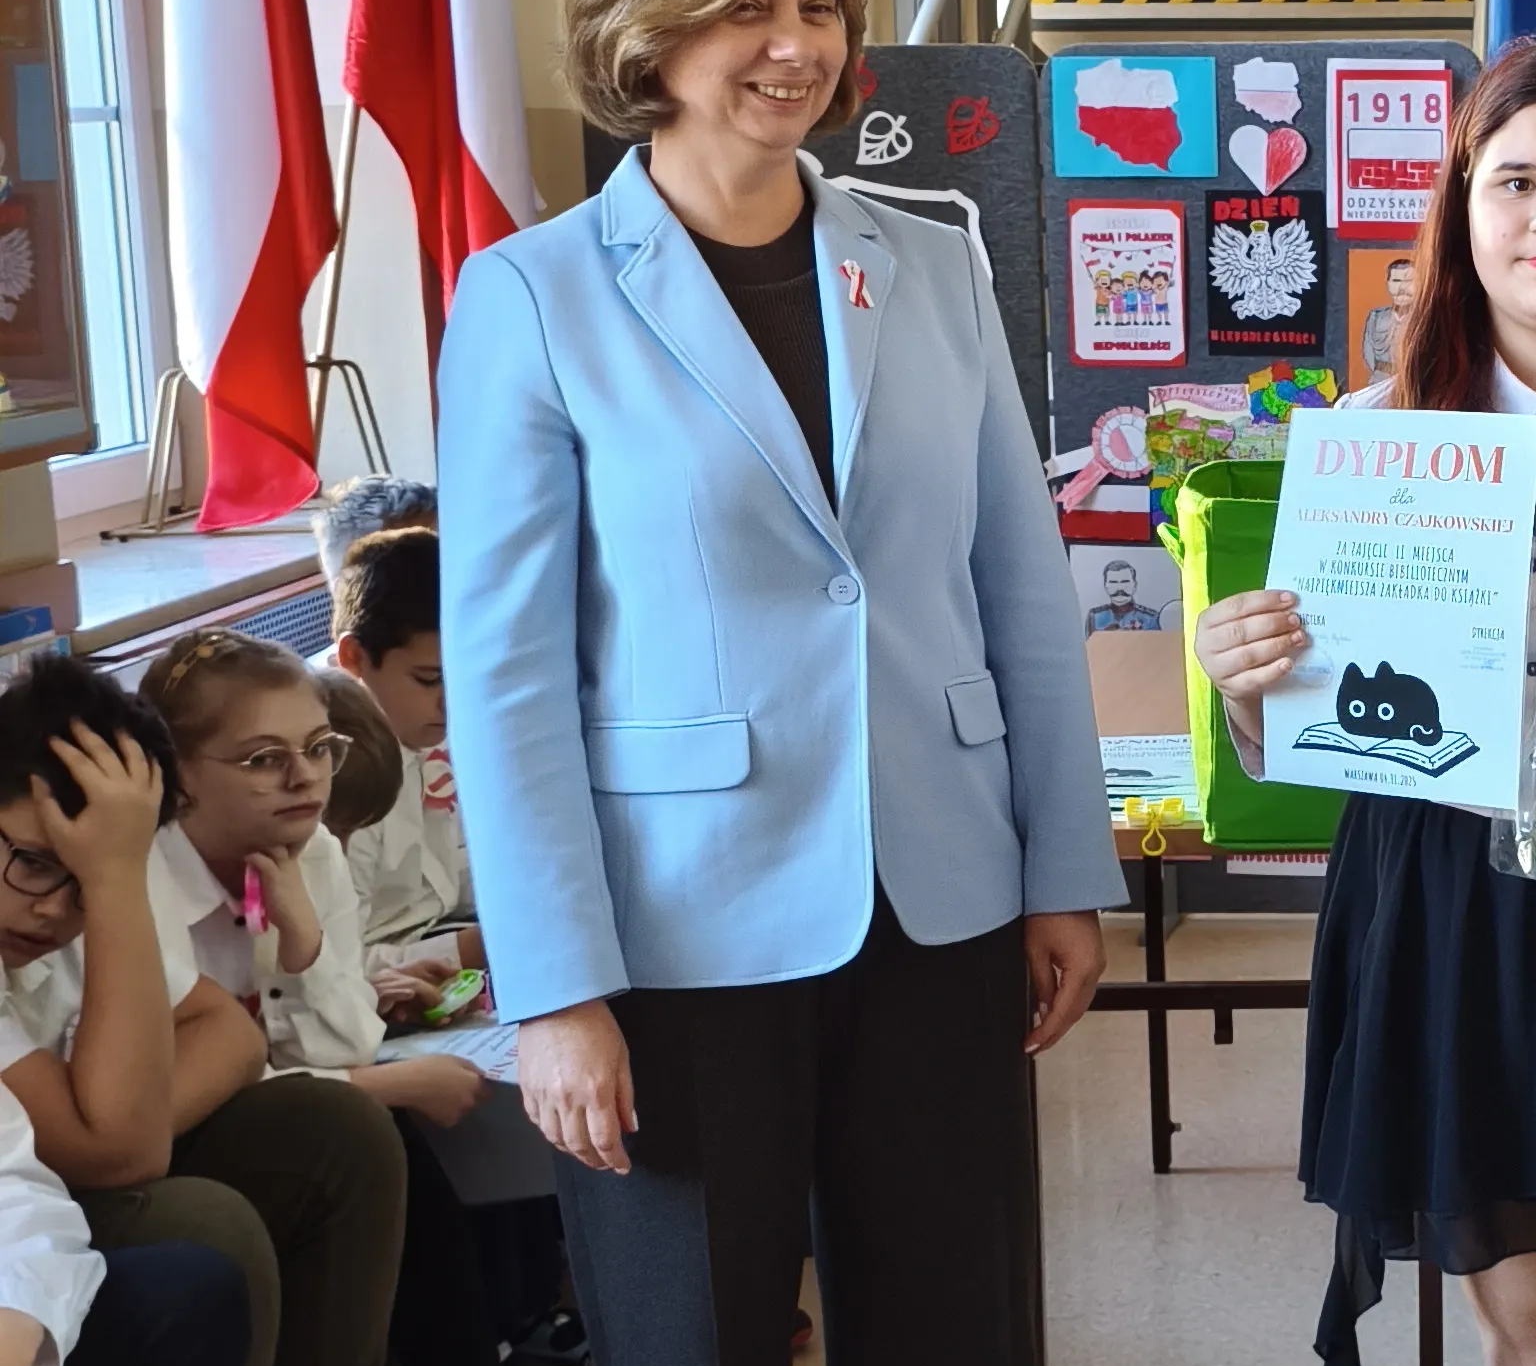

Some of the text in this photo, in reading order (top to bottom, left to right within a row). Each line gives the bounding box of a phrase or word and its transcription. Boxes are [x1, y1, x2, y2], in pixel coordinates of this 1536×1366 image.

[1347, 92, 1442, 123] 1918
[1347, 197, 1428, 208] ODZYSKAN
[1347, 210, 1425, 219] NIEPODLEGŁO
[1314, 439, 1506, 484] DYPLOM
[1389, 488, 1416, 504] dla
[1297, 508, 1514, 533] ALEKSANDRY CZAJKOWSKIEJ
[1336, 541, 1347, 556] ZA
[1395, 545, 1405, 560] II
[1412, 545, 1454, 563] MIEJSCA
[1319, 559, 1328, 574] W
[1331, 560, 1385, 578] KONKURSIE
[1434, 586, 1447, 602] DO
